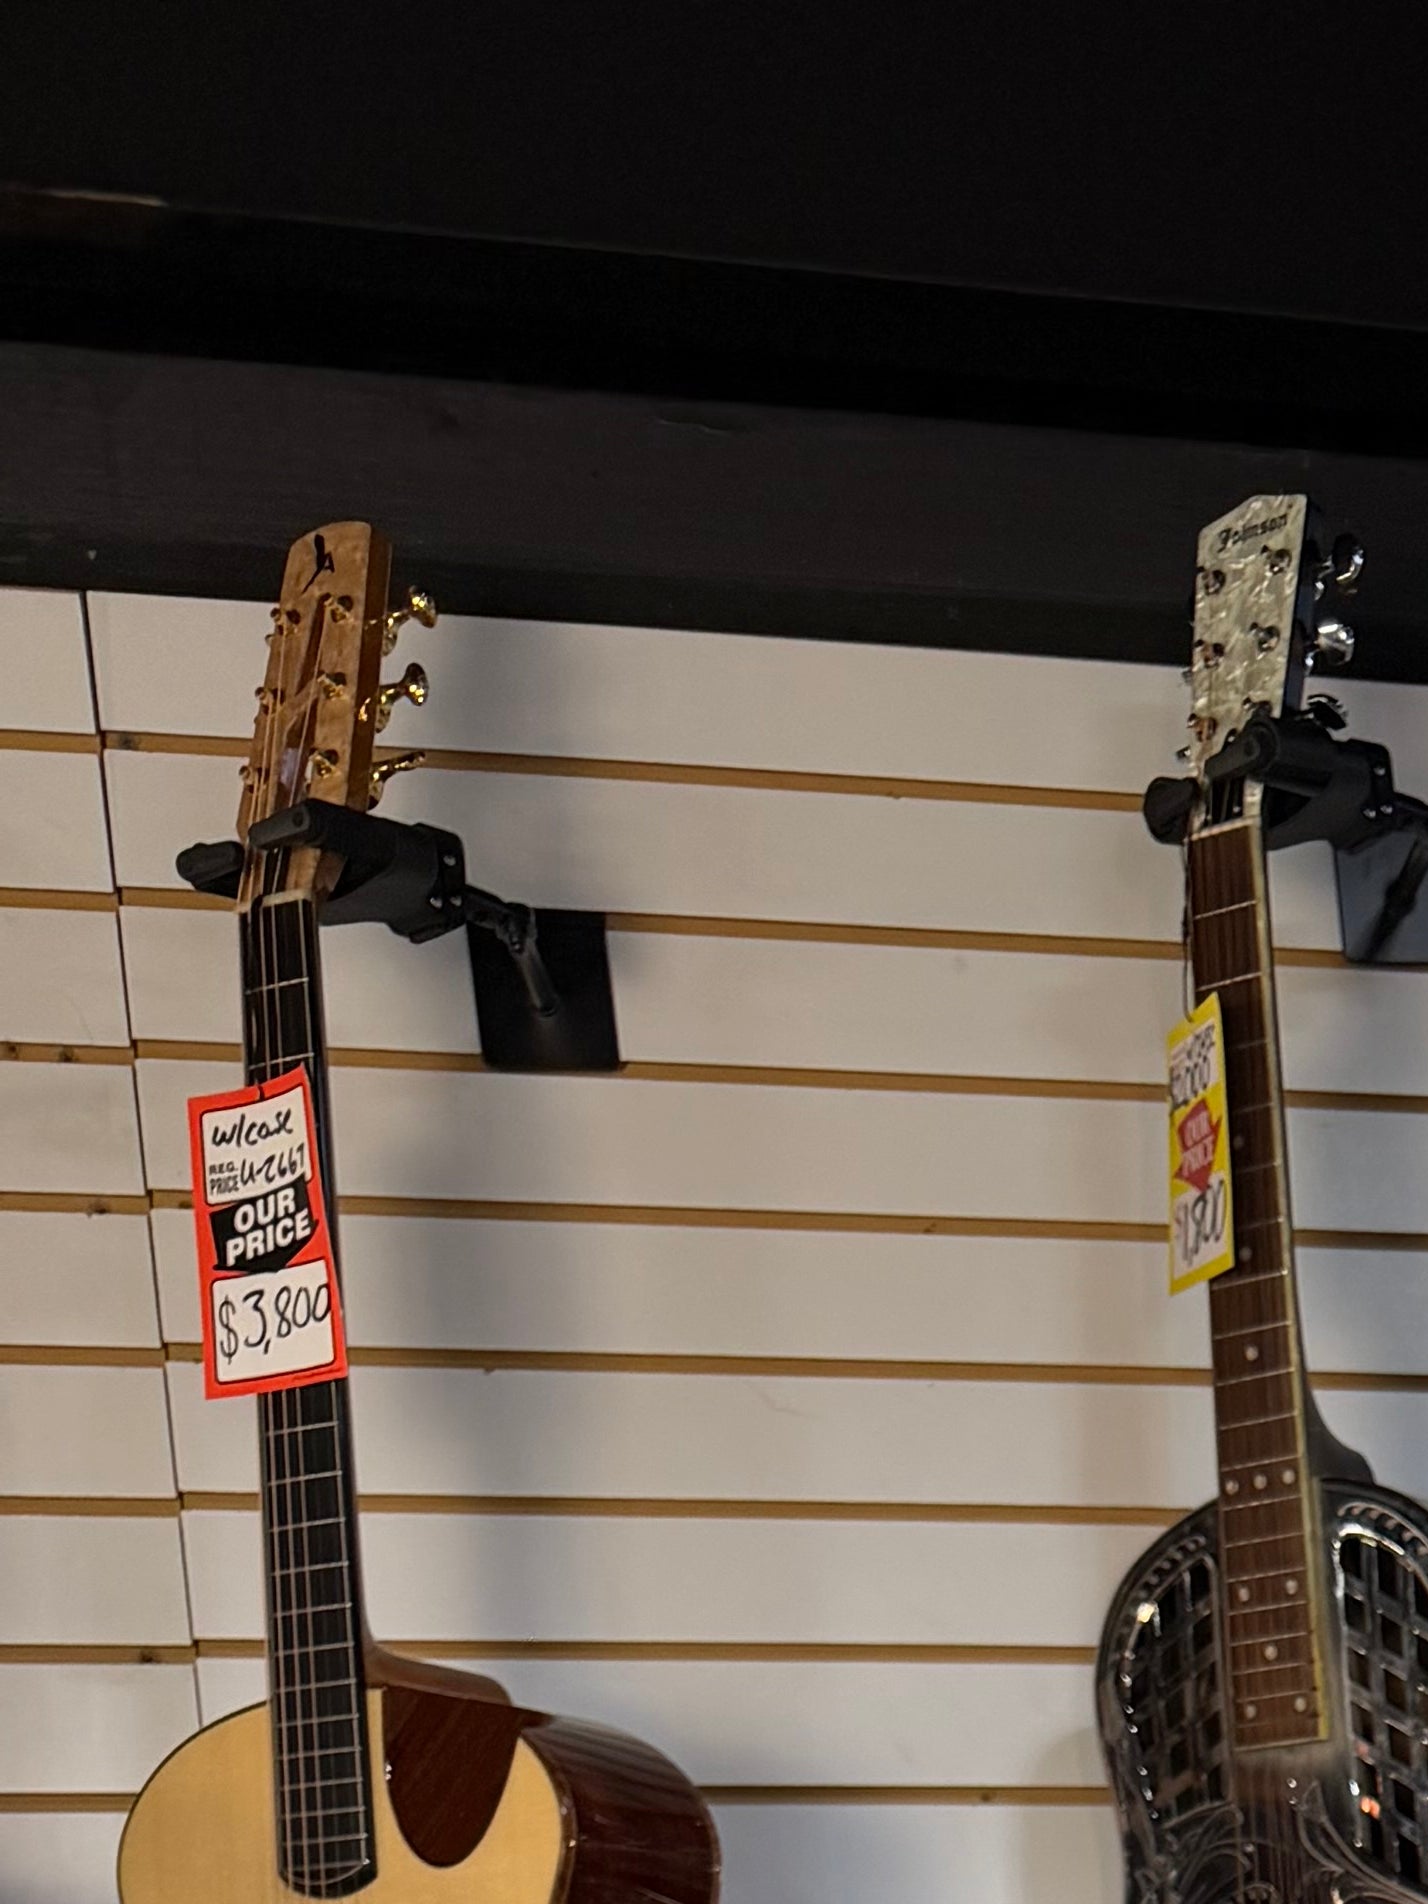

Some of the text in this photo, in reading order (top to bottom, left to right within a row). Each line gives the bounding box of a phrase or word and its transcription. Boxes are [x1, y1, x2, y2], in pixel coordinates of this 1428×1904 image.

[226, 1209, 312, 1268] PRICE
[233, 1186, 297, 1235] OUR
[218, 1283, 333, 1366] $3,800
